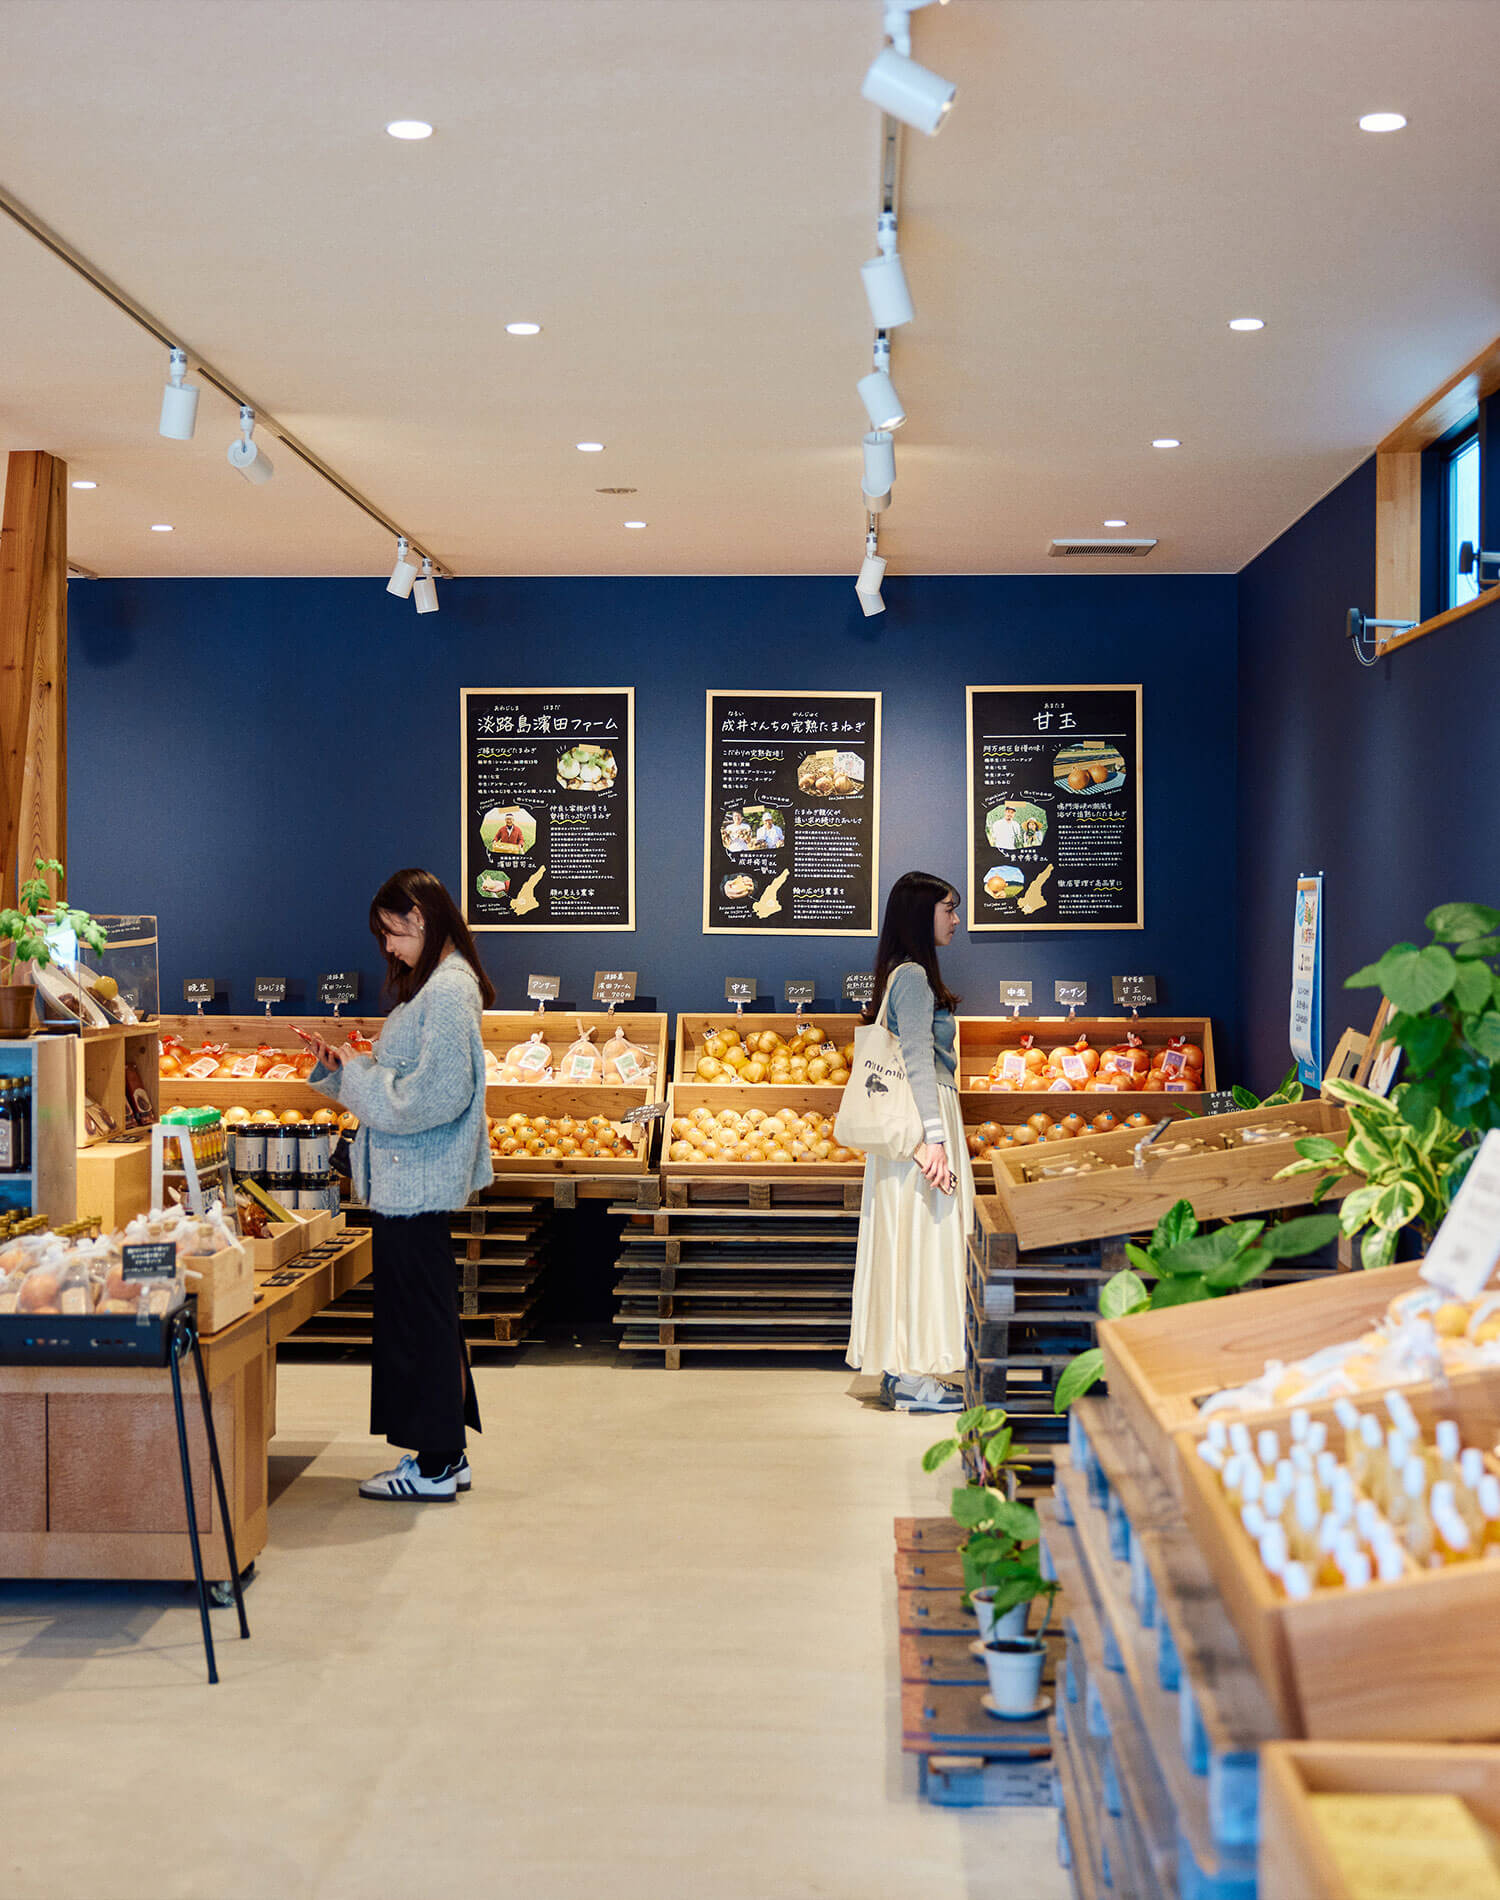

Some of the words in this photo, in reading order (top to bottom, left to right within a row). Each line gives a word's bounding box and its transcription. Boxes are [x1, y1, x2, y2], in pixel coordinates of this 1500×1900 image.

[478, 714, 618, 734] 淡路島濱田ファーム
[722, 719, 866, 734] 成井さんちの完熟たまねぎ
[1033, 712, 1076, 730] 甘玉
[731, 983, 751, 994] 中生
[1059, 988, 1086, 997] ターザン
